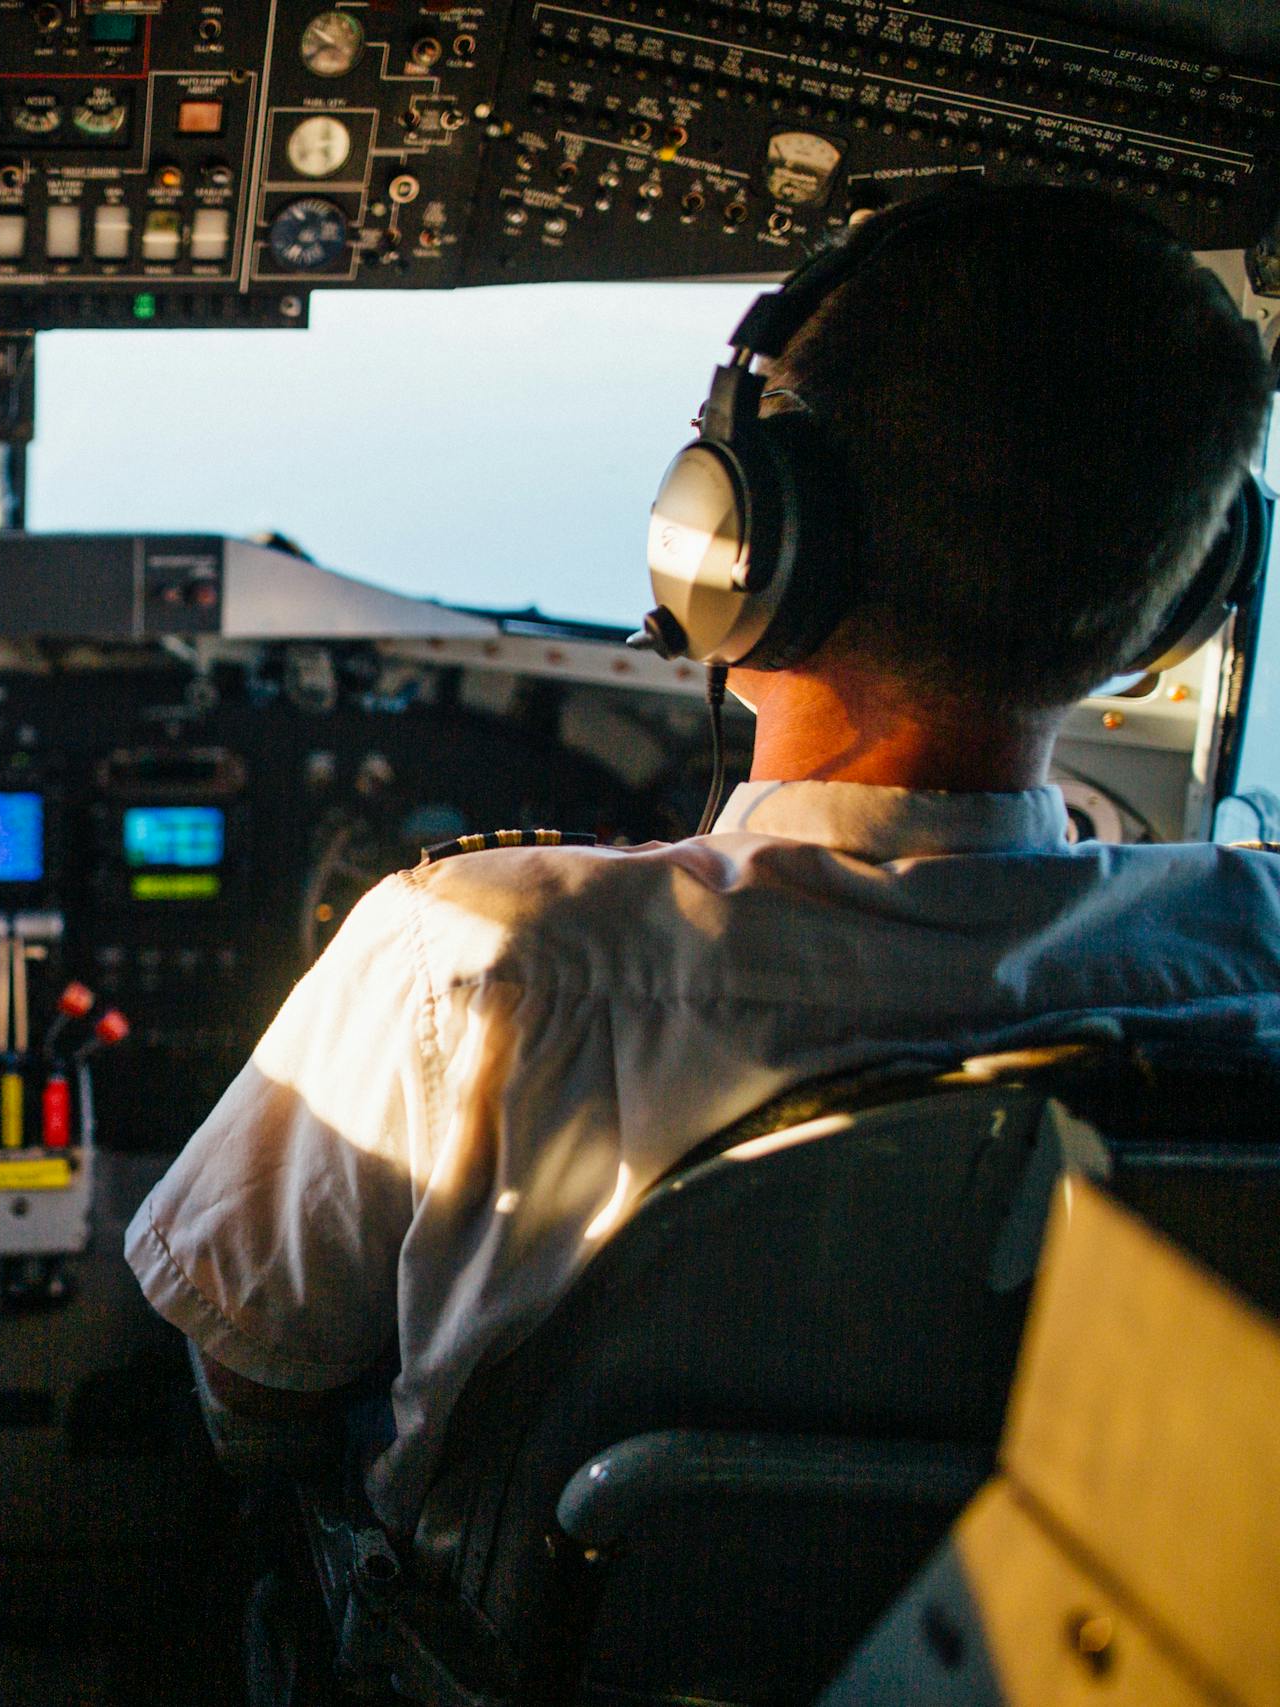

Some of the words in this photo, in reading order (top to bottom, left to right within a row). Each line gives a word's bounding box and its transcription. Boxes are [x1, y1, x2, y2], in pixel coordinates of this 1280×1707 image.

[1032, 56, 1051, 66] NAV
[1063, 62, 1082, 73] COM
[1113, 48, 1137, 62] LEFT
[1136, 53, 1180, 71] AVIONICS
[1180, 60, 1200, 74] BUS
[1088, 66, 1118, 80] PILOTS
[1035, 115, 1062, 129] RIGHT
[1062, 122, 1104, 139] AVIONICS
[1103, 130, 1123, 143] BUS
[1035, 128, 1054, 139] COM
[873, 167, 913, 181] COCKPIT
